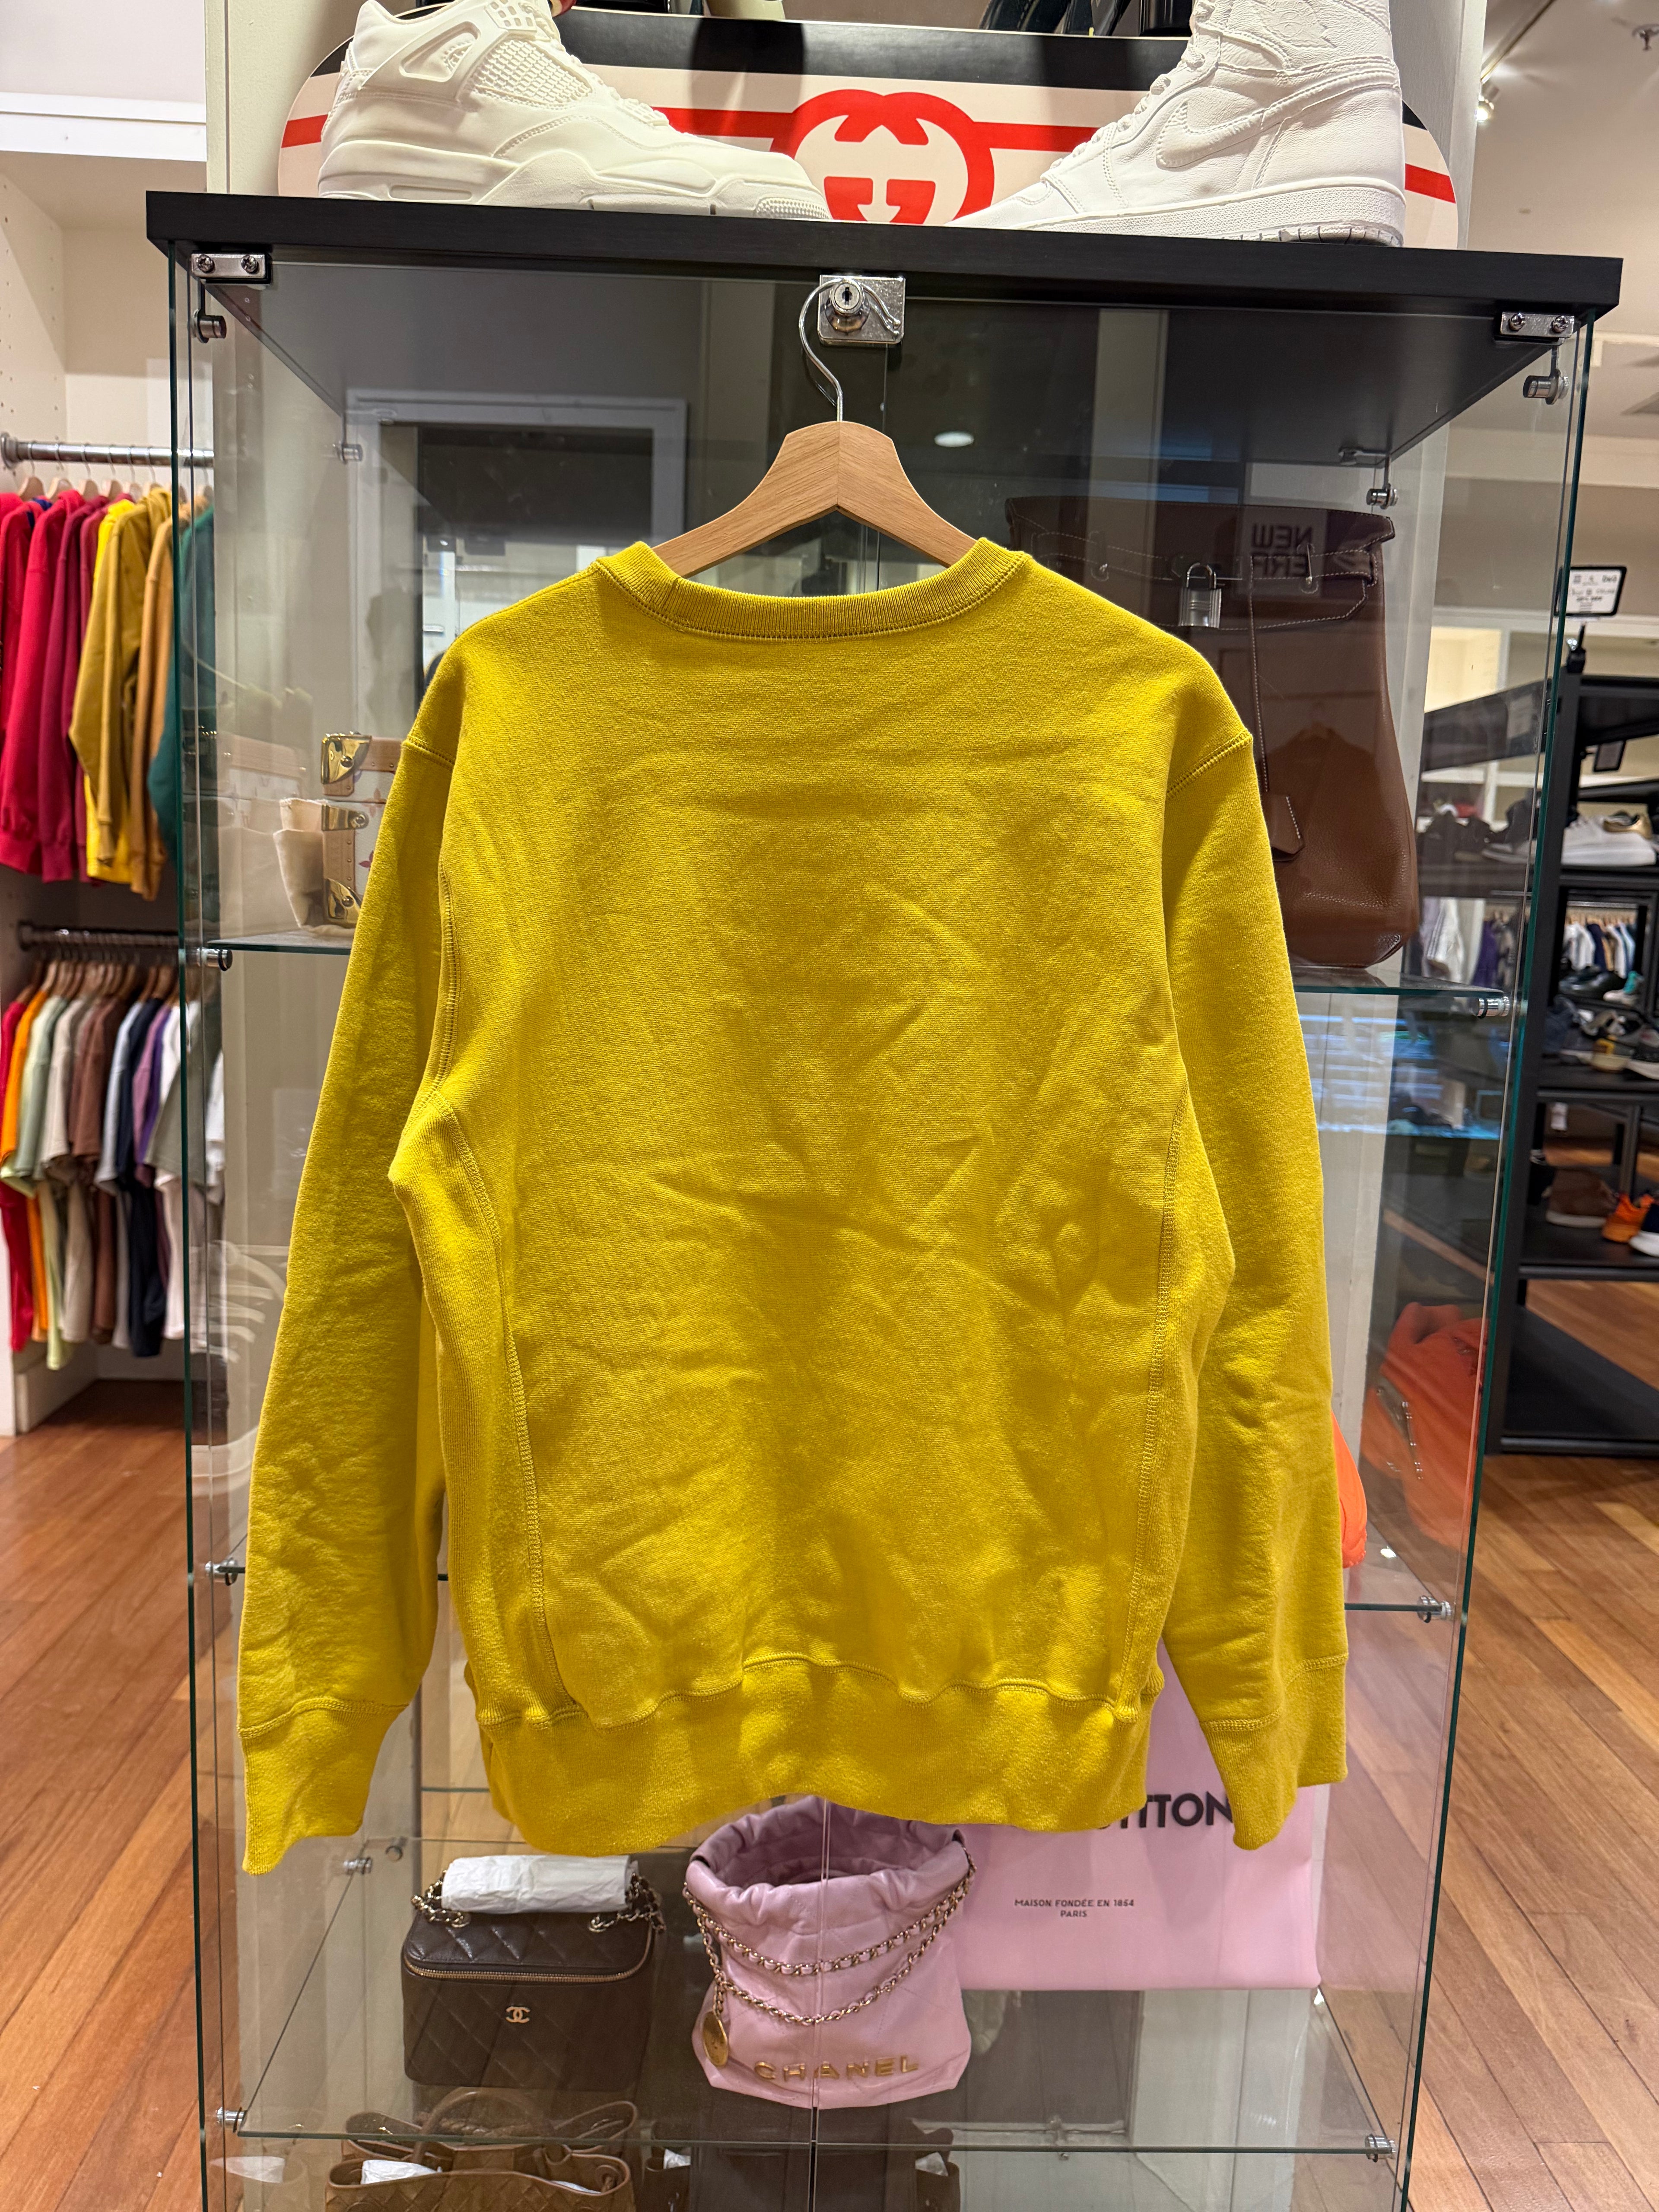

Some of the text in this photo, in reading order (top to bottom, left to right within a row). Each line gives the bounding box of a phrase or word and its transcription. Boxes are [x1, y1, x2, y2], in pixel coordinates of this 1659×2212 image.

[1098, 1791, 1233, 1829] TTON
[1055, 1898, 1094, 1907] FONDÉE
[754, 2055, 919, 2081] CHANEL
